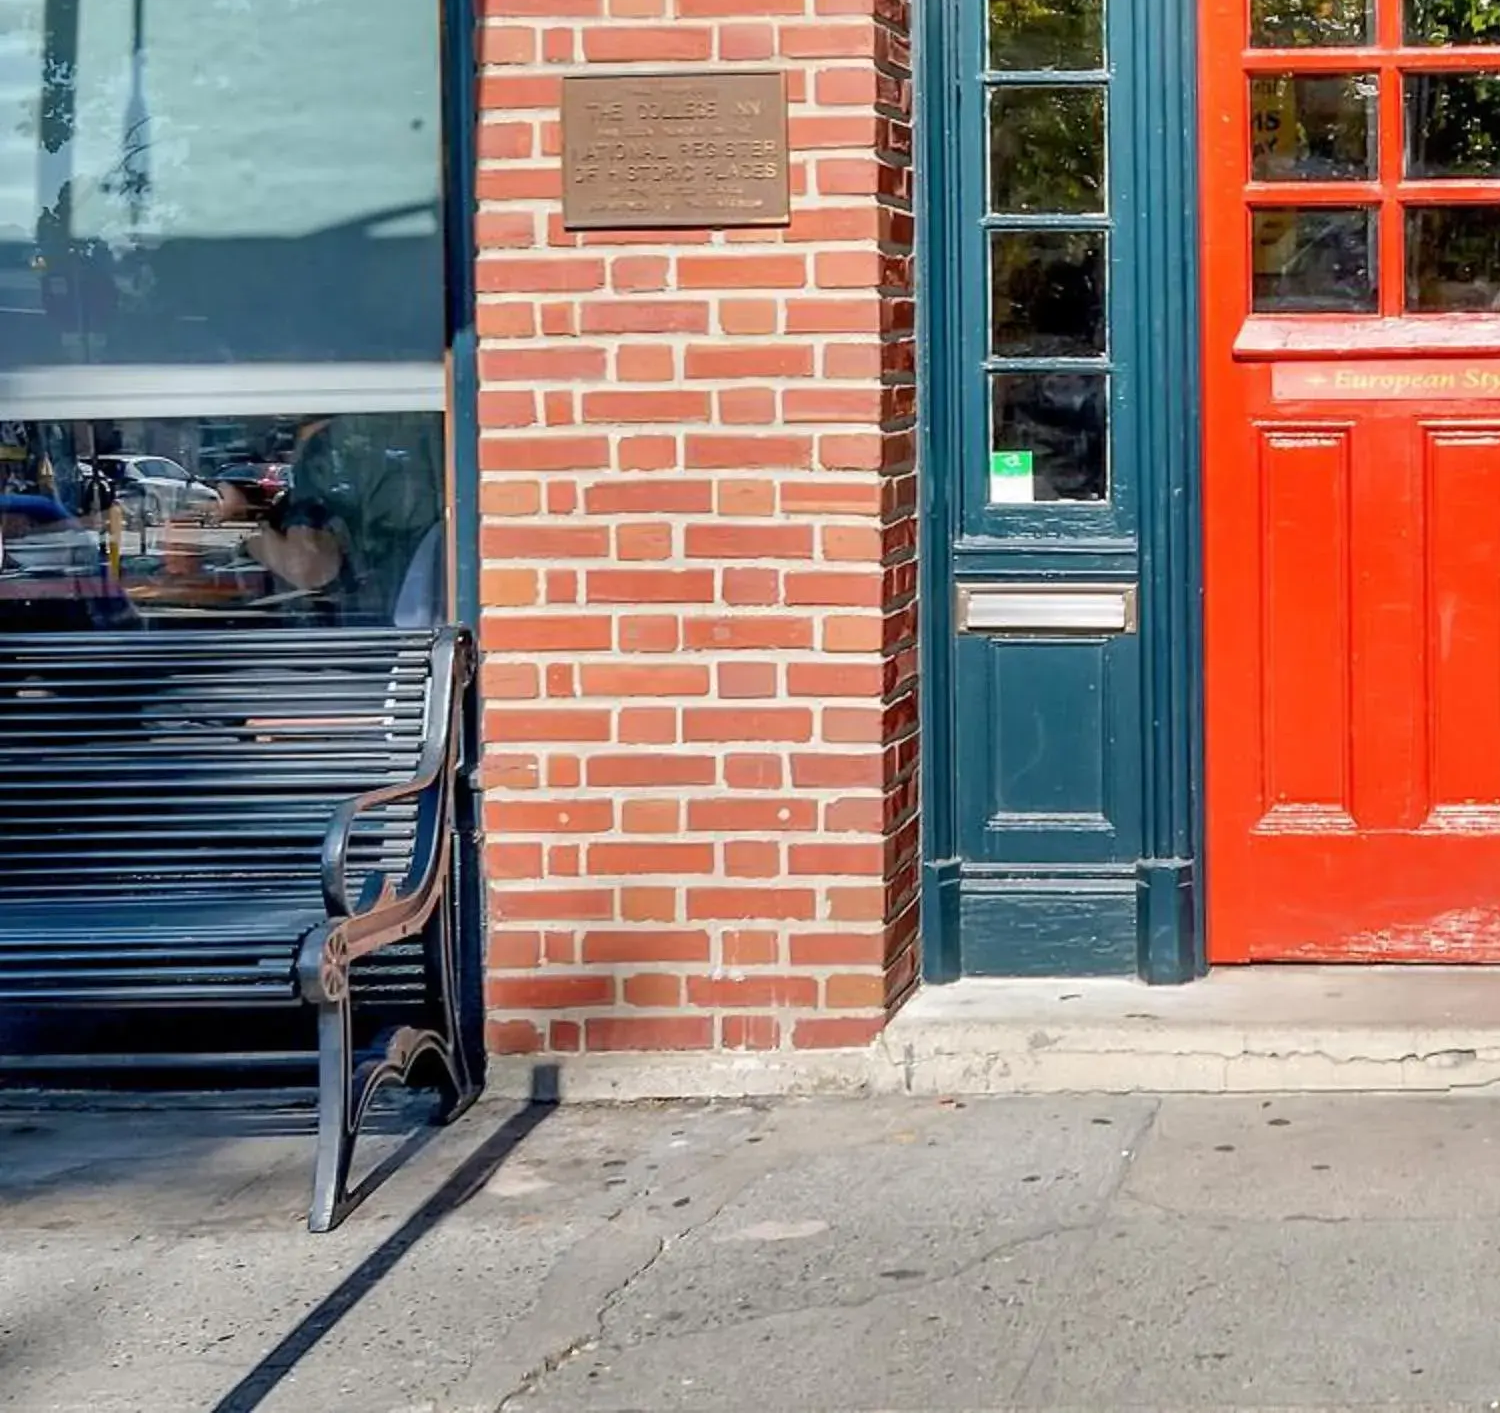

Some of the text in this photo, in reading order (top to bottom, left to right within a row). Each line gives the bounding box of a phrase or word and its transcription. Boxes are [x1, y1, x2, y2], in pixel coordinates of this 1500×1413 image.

[679, 140, 779, 159] REGSTER
[607, 164, 697, 183] HSTORC
[1334, 369, 1456, 394] European
